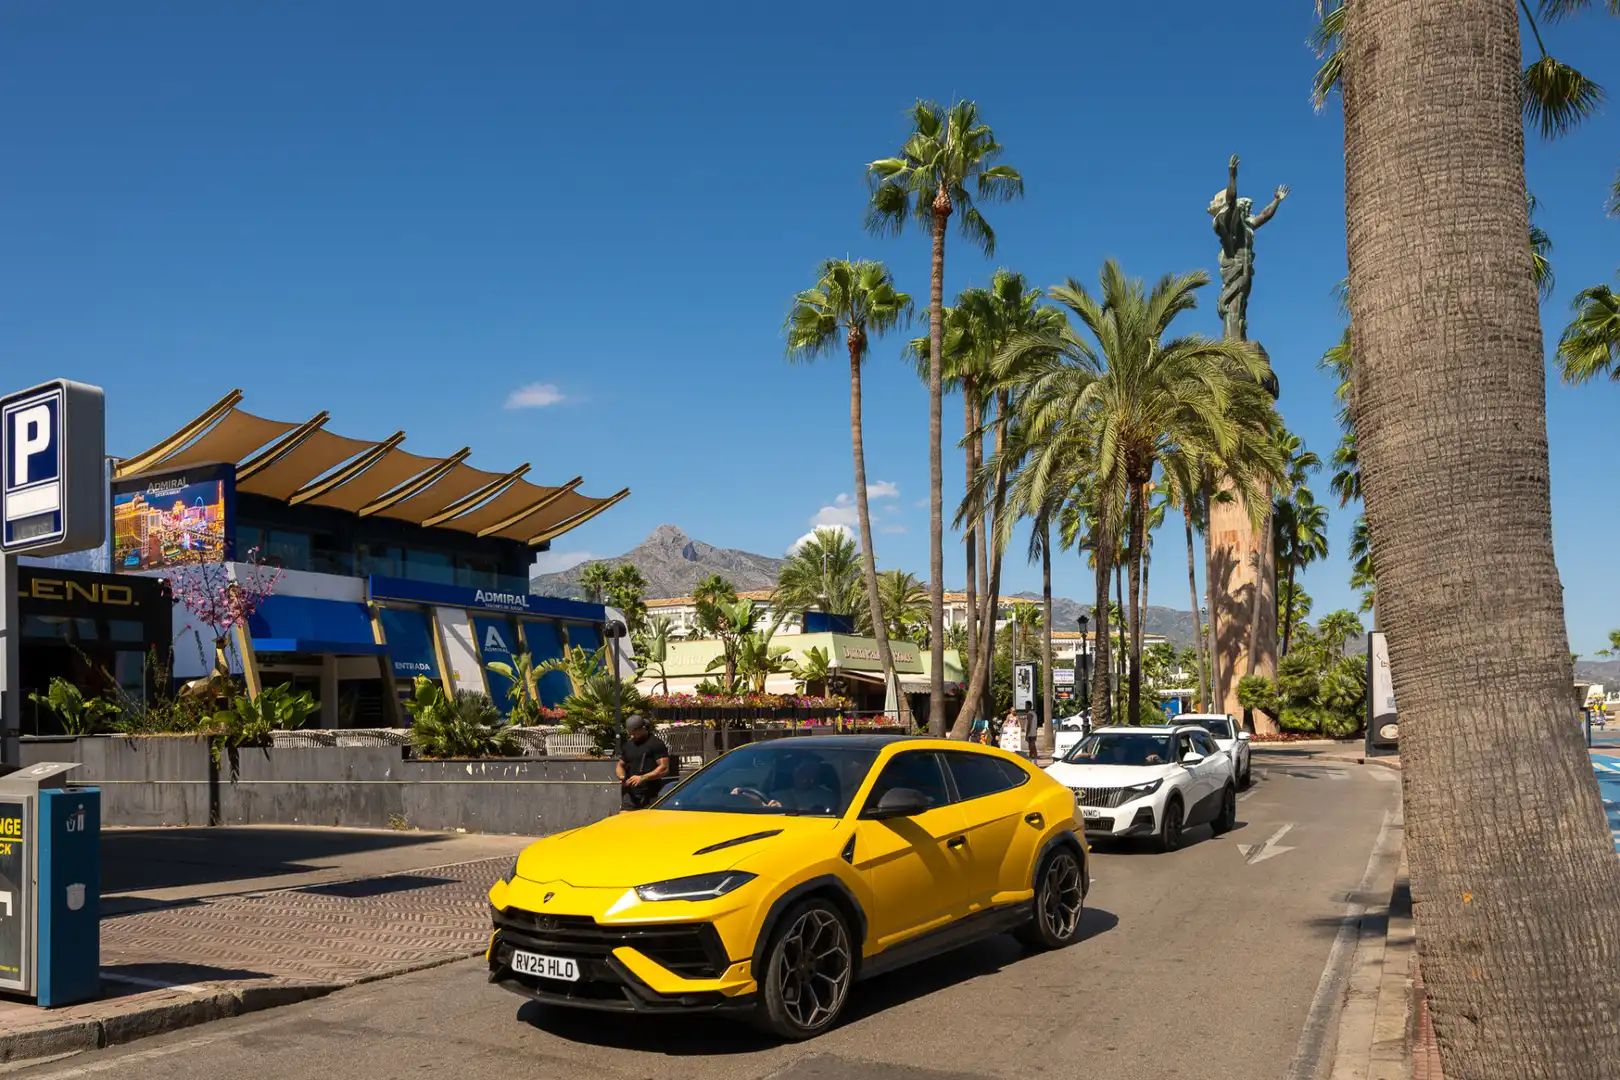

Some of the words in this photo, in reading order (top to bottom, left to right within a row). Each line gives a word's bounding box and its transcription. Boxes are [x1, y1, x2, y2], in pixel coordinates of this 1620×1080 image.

[14, 405, 50, 486] P
[146, 476, 189, 495] ADMIRAL
[475, 589, 530, 607] ADMIRAL
[394, 661, 430, 671] ENTRADA
[515, 953, 545, 974] RV25
[547, 959, 574, 978] HLO
